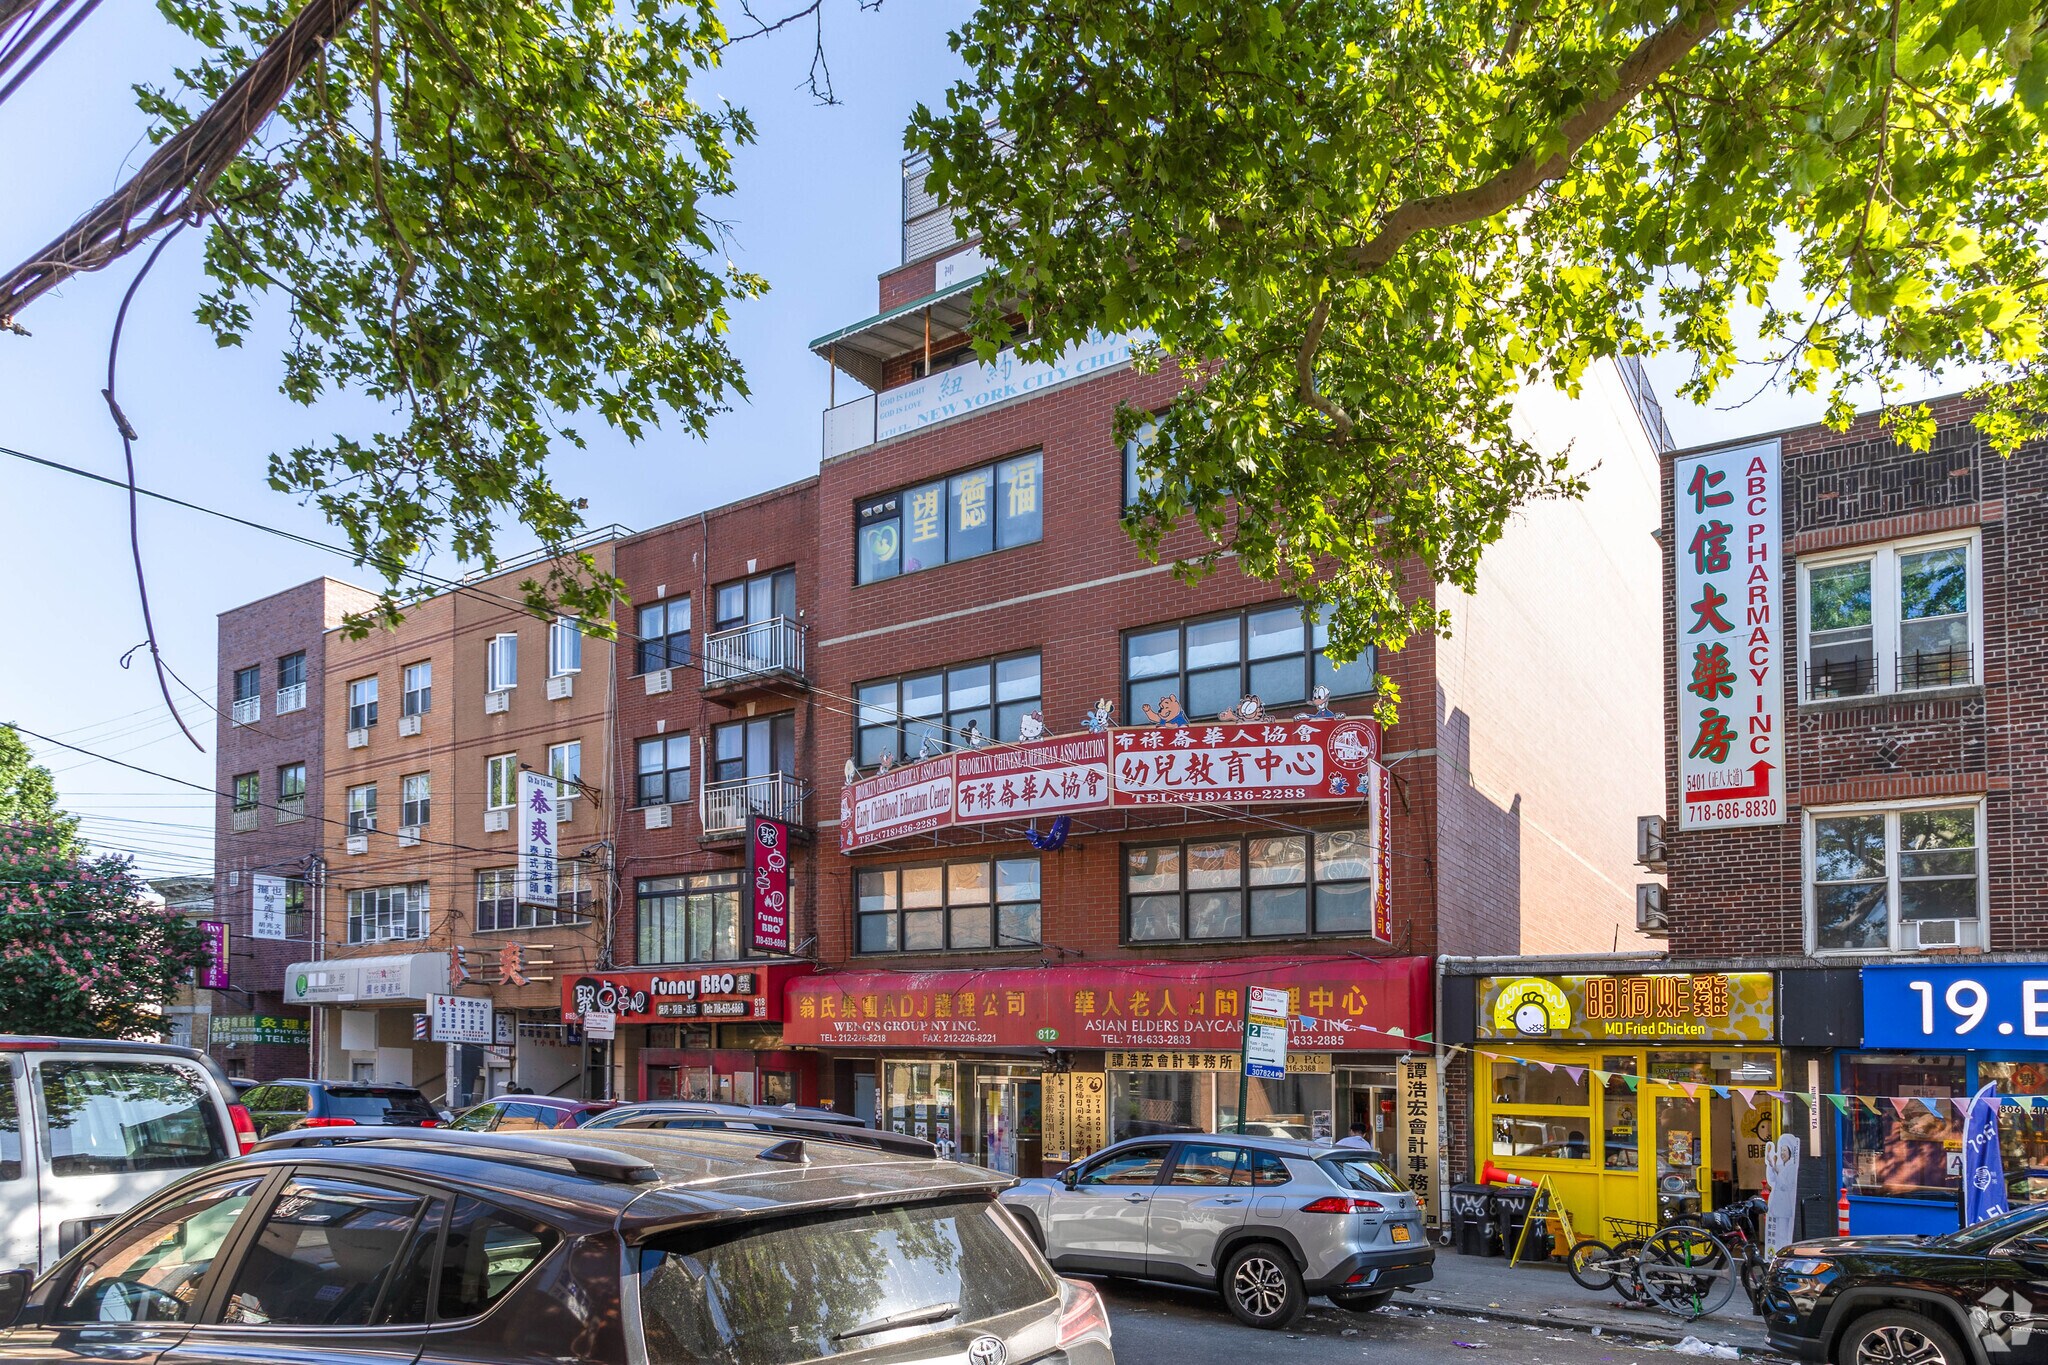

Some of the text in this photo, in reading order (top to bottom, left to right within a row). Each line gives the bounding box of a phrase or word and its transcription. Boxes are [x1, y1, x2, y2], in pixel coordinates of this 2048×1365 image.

[880, 386, 926, 407] GOD IS LIGHT
[917, 401, 959, 425] NEW
[963, 383, 1018, 412] YORK
[1023, 364, 1070, 393] CITY
[880, 401, 922, 420] GOD IS LOVE
[1686, 463, 1738, 766] 仁信大藥房
[1745, 456, 1771, 755] ABC PHARMACY INC
[959, 739, 1106, 776] BROOKLYN CHINESE-AMERICAN ASSOCIATION
[919, 757, 953, 781] ASSOCIATION
[1121, 748, 1316, 788] 幼兒教育中心
[1687, 773, 1705, 791] 5401
[856, 784, 951, 831] Early Childhood Education Center
[1689, 799, 1777, 822] 718-686-8830
[530, 788, 552, 846] 泰爽
[757, 911, 784, 926] Funny
[762, 923, 781, 934] BBQ
[651, 976, 696, 1000] Funny
[700, 973, 735, 994] BBQ
[1585, 975, 1729, 1019] 明洞炸雞
[833, 1020, 981, 1031] WENG'S GROUP NY INC.
[1038, 1029, 1057, 1040] 812
[1085, 1019, 1127, 1032] ASIAN
[1132, 1019, 1179, 1032] ELDERS
[1184, 1020, 1245, 1033] DAYCAR
[1324, 1018, 1356, 1032] INC.
[1252, 1025, 1258, 1036] 2
[1605, 1022, 1705, 1035] MD Fried Chicken
[265, 1034, 290, 1043] TEL:
[820, 1033, 837, 1042] TEL:
[922, 1033, 997, 1043] FAX: 212-226-8221
[1101, 1034, 1191, 1045] TEL: 718-633-2883
[1112, 1053, 1233, 1069] 譚浩宏會計事務所
[1950, 1155, 1963, 1169] A
